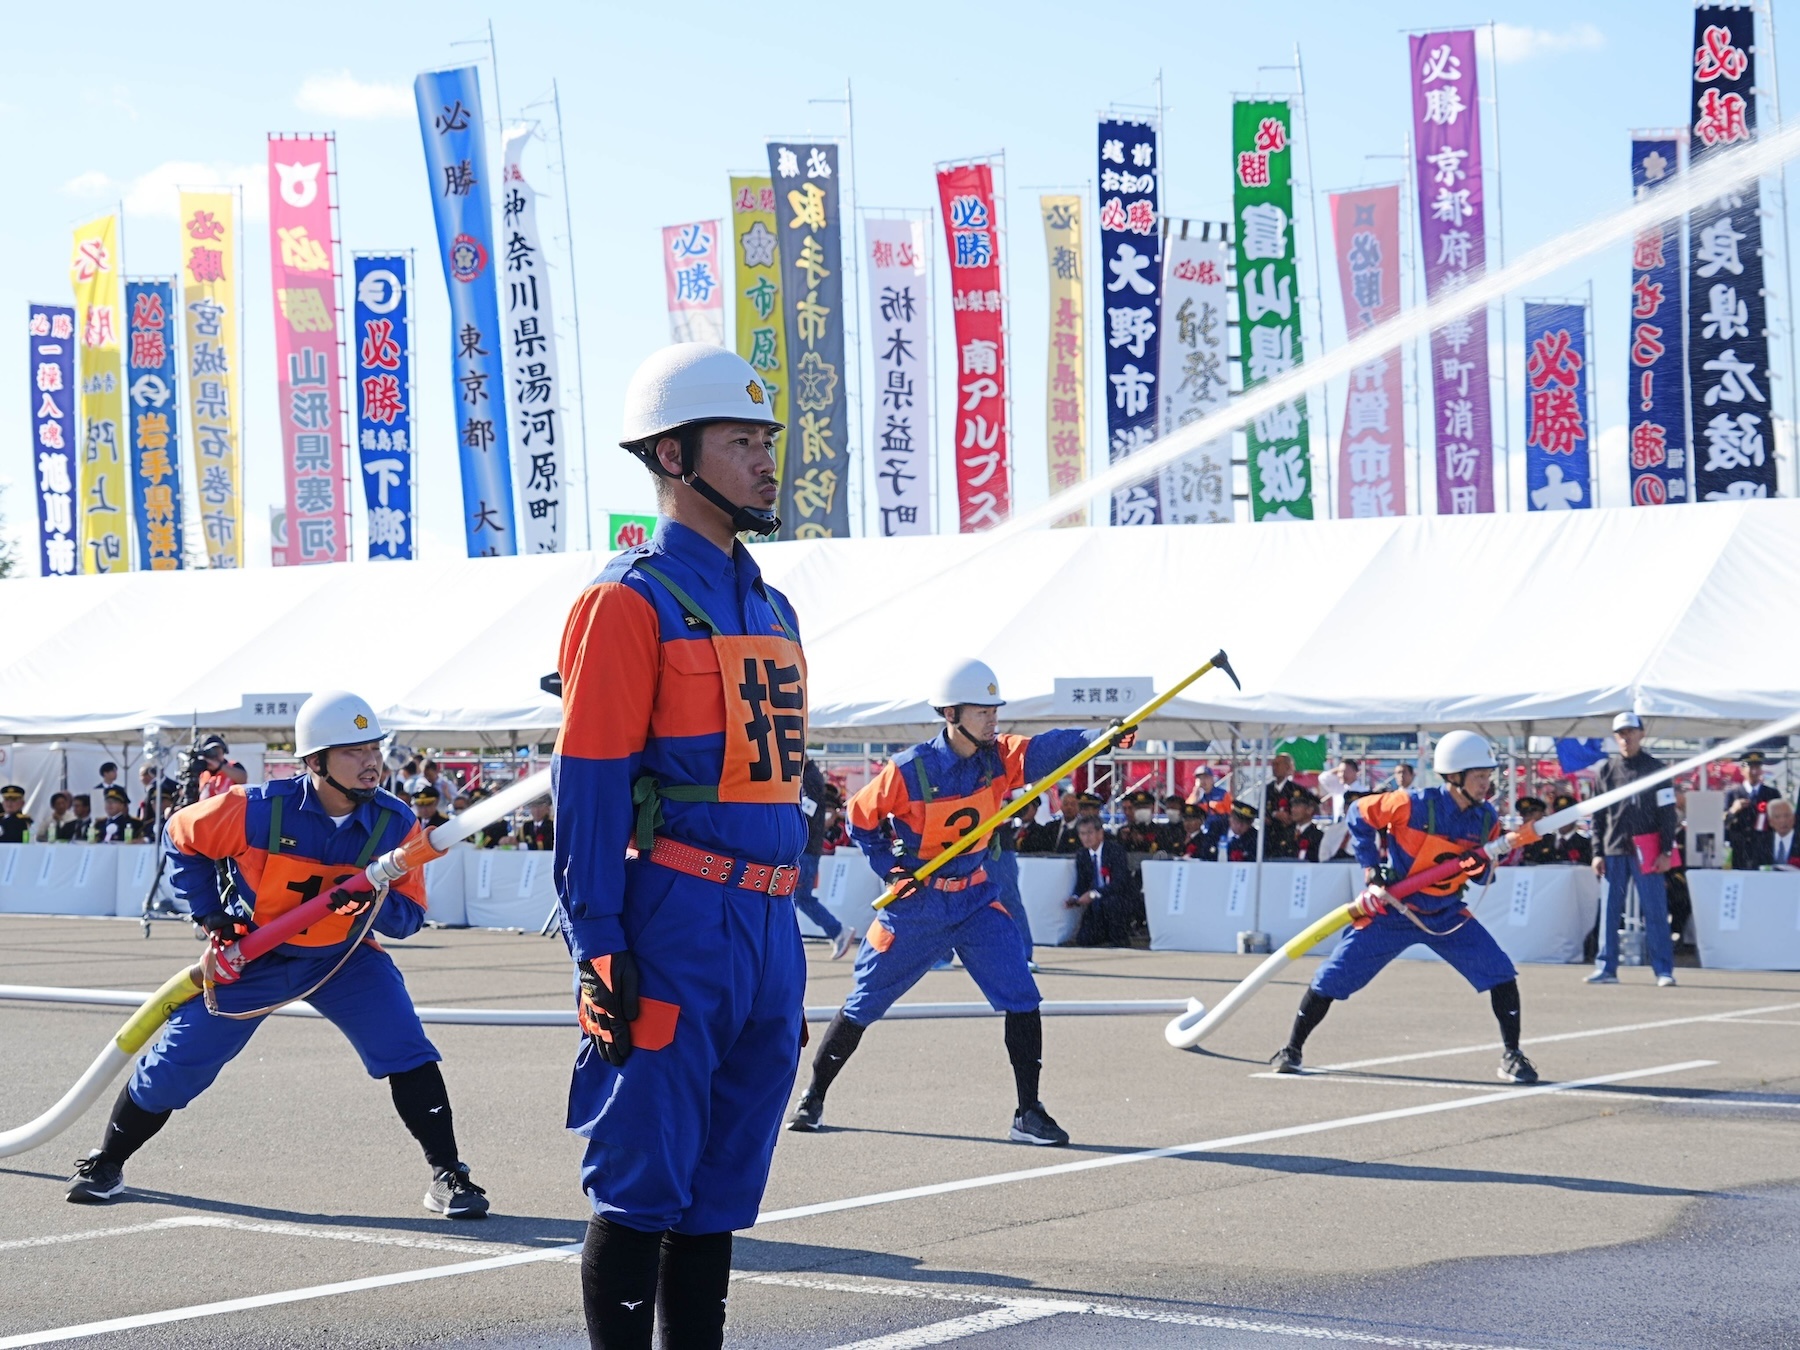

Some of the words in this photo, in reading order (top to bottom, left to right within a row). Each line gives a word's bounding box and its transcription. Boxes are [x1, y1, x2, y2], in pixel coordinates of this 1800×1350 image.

[1421, 44, 1466, 126] 必勝
[435, 100, 478, 198] 必勝
[1101, 168, 1154, 195] おおの
[1102, 139, 1153, 167] 越前
[735, 187, 776, 214] 必勝
[950, 195, 992, 269] 必勝
[1101, 197, 1155, 235] 必勝
[673, 225, 716, 302] 必勝
[954, 289, 1001, 313] 山梨県
[1173, 260, 1222, 285] 必勝
[30, 313, 73, 340] 必勝
[131, 292, 166, 369] 必勝
[37, 344, 64, 449] 一操入魂
[362, 318, 407, 425] 必勝
[458, 323, 495, 452] 東京都
[1528, 328, 1586, 456] 必勝
[360, 428, 409, 452] 福島県
[961, 338, 999, 526] 南アルプス
[39, 452, 77, 572] 旭川市
[363, 457, 407, 561] 下郷
[473, 501, 505, 556] 大
[738, 657, 804, 783] 指
[941, 807, 980, 854] 3
